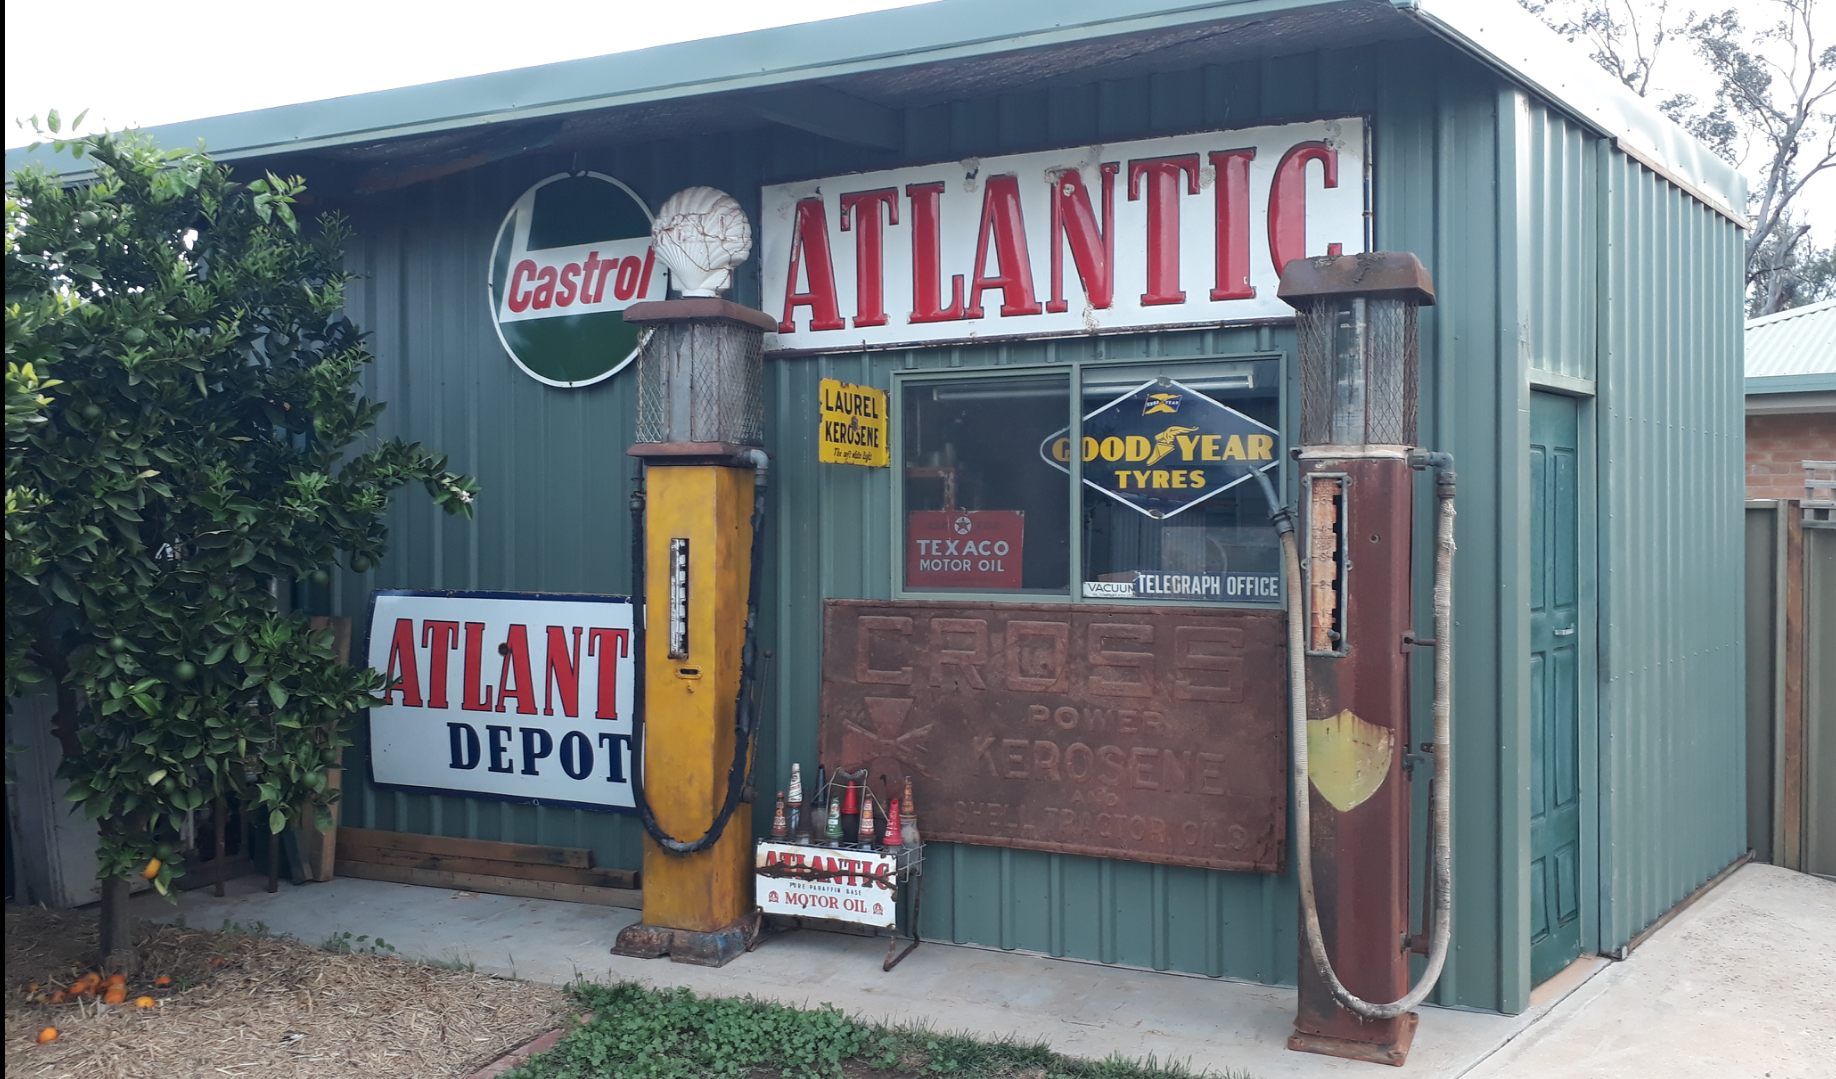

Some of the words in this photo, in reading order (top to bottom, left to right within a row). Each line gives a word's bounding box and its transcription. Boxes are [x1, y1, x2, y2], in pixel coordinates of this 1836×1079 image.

[778, 139, 1343, 335] ATLANTIC
[508, 246, 655, 313] Castrol
[825, 388, 879, 420] LAUREL
[825, 420, 880, 449] KEROSENE
[1052, 435, 1151, 462] GOOD
[1176, 434, 1274, 462] YEAR
[1114, 469, 1207, 489] TYRES
[915, 539, 1010, 556] TEXACO
[919, 558, 972, 572] MOTOR
[977, 558, 1005, 572] OIL
[1138, 574, 1220, 596] TELEGRAPH
[1226, 575, 1279, 597] OFFICE
[383, 618, 630, 721] ATLANT
[856, 614, 1245, 704] CROSS
[1027, 703, 1168, 735] POWER
[447, 722, 632, 783] DEPOT
[972, 735, 1227, 796] KEROSENE
[1069, 788, 1120, 808] AND
[1044, 805, 1167, 845] TRACTOR
[1180, 820, 1249, 851] OILS
[785, 891, 839, 910] MOTOR
[843, 897, 867, 914] OIL
[789, 881, 806, 890] PURE
[845, 887, 862, 896] BASE
